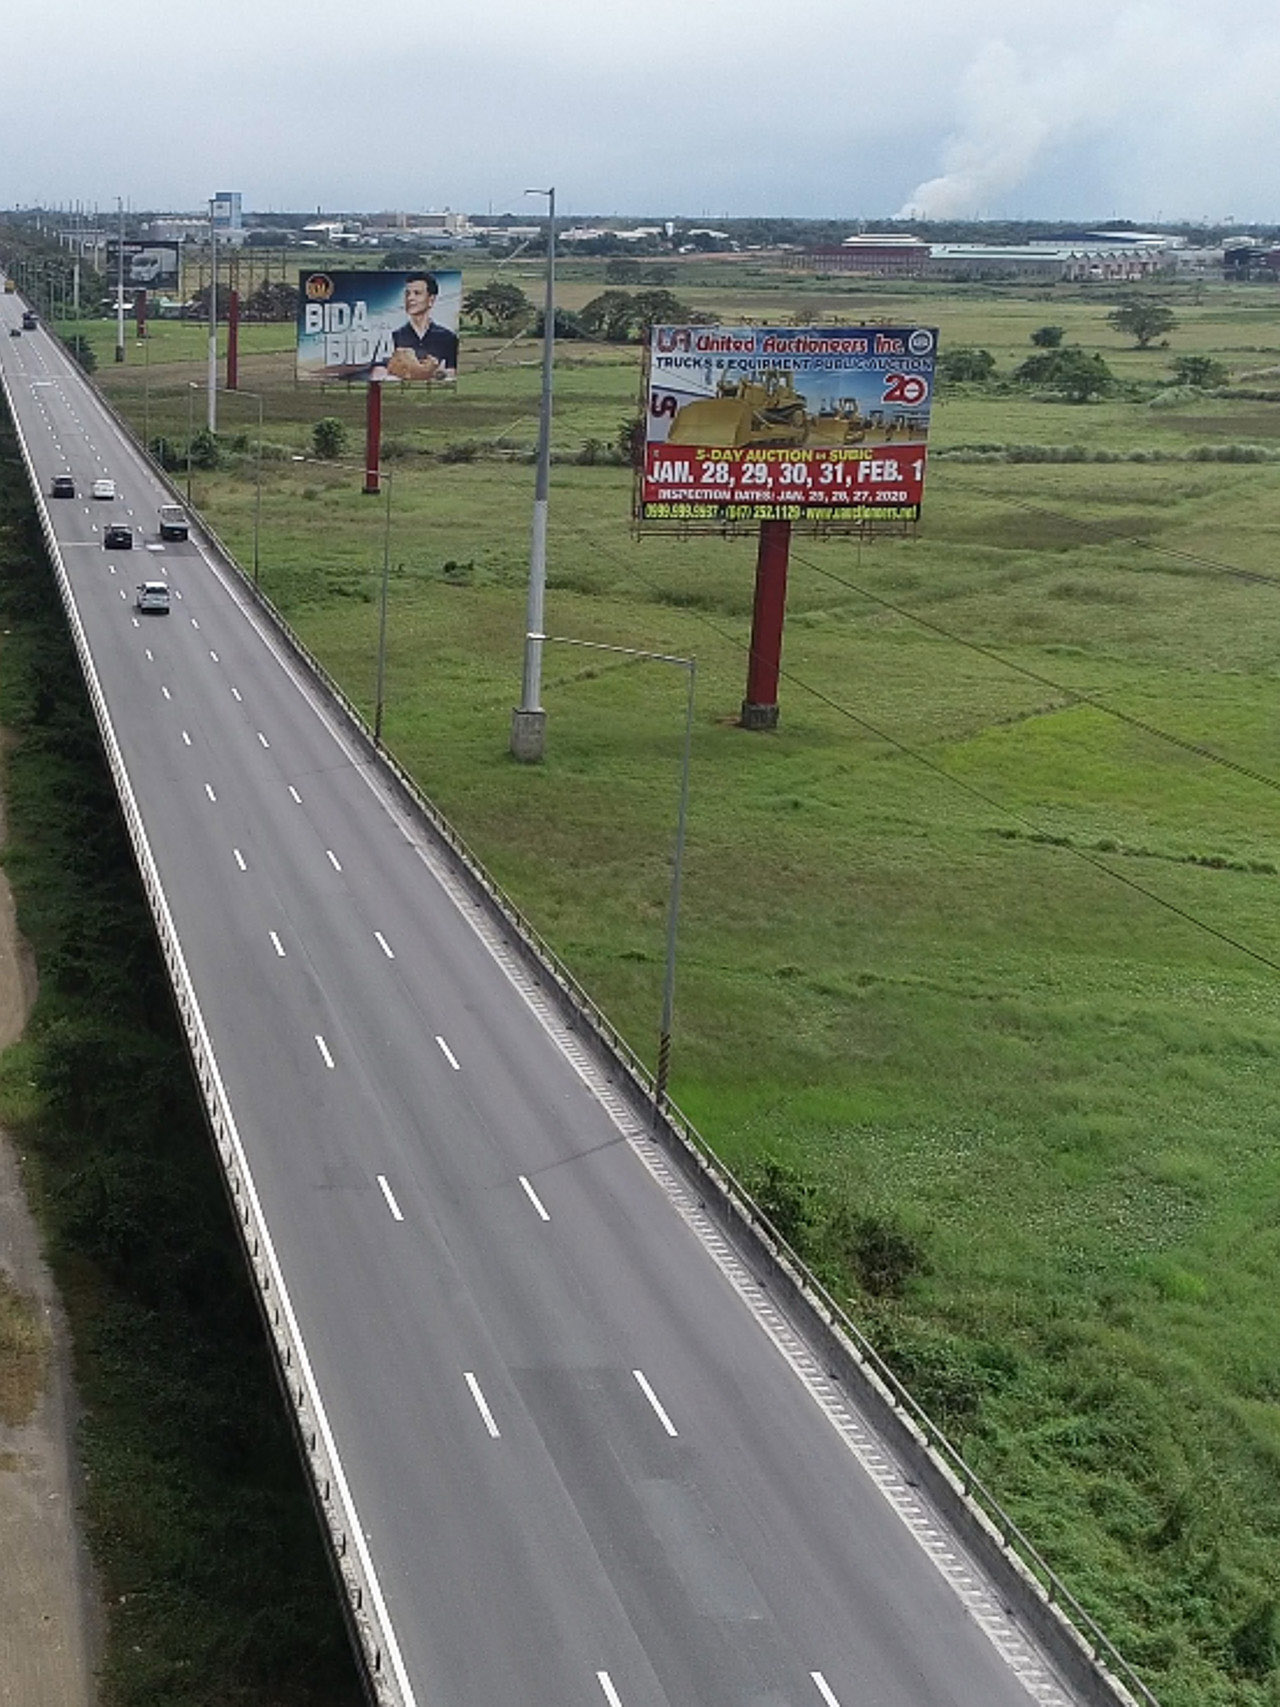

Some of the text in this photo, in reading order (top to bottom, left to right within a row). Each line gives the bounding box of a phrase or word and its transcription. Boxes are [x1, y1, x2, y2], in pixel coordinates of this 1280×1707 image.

[305, 301, 369, 334] BIDA
[324, 332, 395, 367] BIDA
[696, 334, 756, 353] United
[763, 333, 868, 354] Auctioneers
[874, 333, 905, 355] Inc.
[656, 357, 933, 371] TRUCKS & EQUIPMENT PUBLIC AUCTION
[882, 373, 928, 406] 20
[696, 449, 743, 461] 5-DAY
[746, 449, 812, 461] AUCTION
[830, 449, 873, 461] SUBIC
[647, 459, 923, 488] JAN. 28, 29, 30, 31, FEB. 1
[658, 489, 732, 500] INSPECTION
[777, 490, 805, 501] JAN.
[875, 490, 908, 502] 2020
